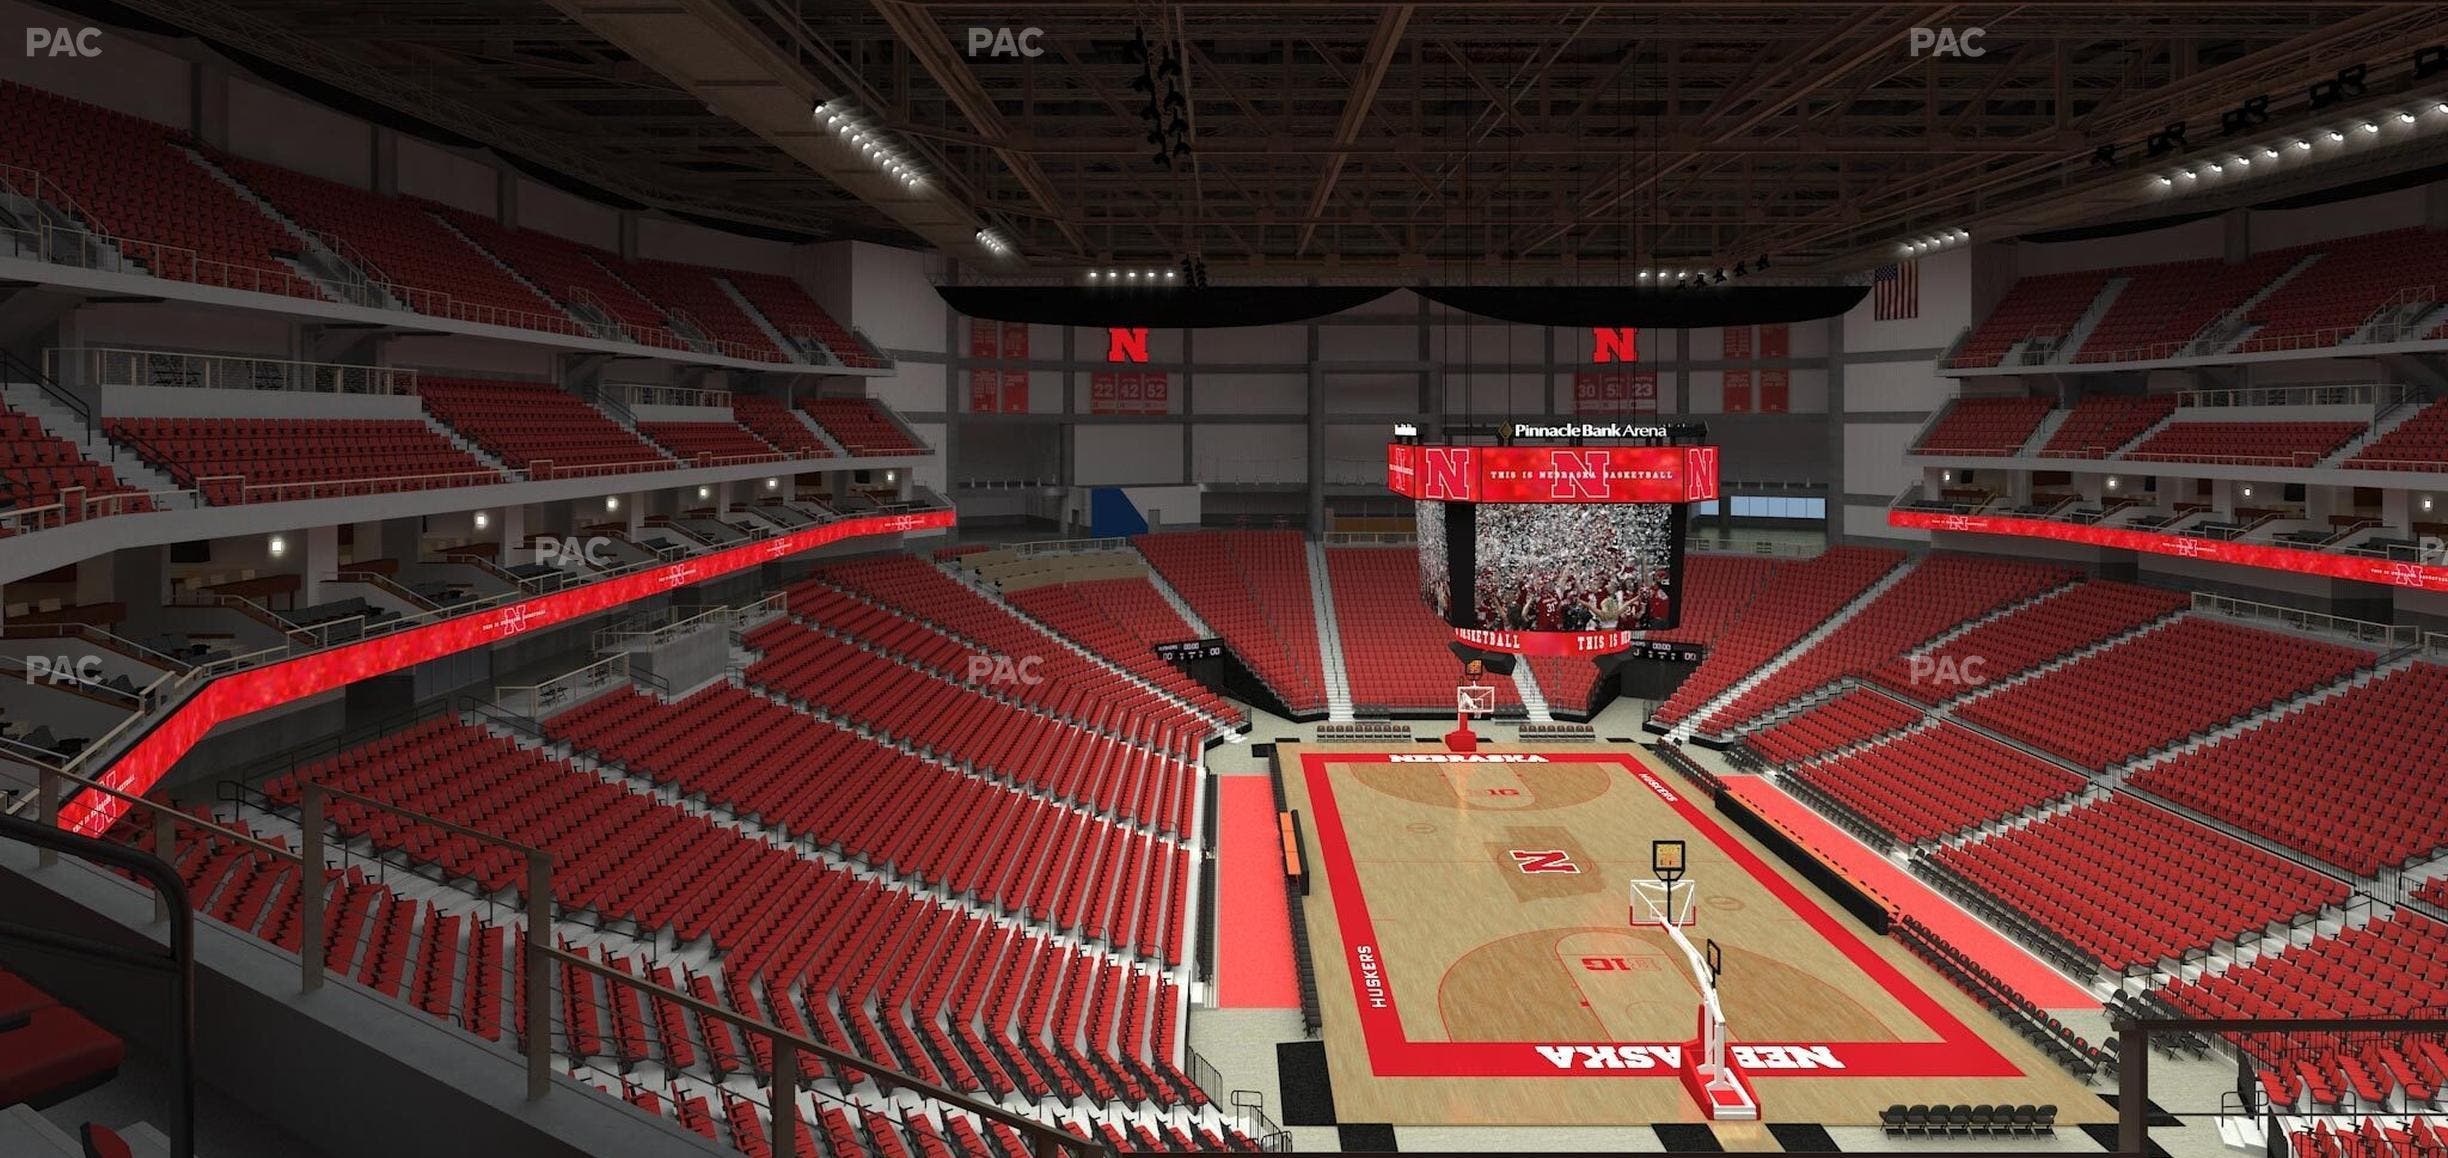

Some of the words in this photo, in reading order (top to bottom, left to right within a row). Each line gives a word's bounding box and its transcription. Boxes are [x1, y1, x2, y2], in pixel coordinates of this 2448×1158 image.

[1108, 328, 1149, 362] N
[1593, 328, 1639, 363] N
[1095, 383, 1114, 398] 22
[1120, 383, 1139, 398] 42
[1578, 386, 1596, 399] 30
[1632, 384, 1653, 398] 23
[1515, 423, 1581, 437] Pinnacle
[1582, 423, 1621, 437] Bank
[1622, 424, 1667, 437] Arena
[1426, 449, 1469, 499] N
[1490, 471, 1516, 479] THIS
[1522, 471, 1533, 479] IS
[1539, 471, 1596, 479] NEBRASKA
[1603, 471, 1673, 479] BASKETBALL
[1551, 451, 1609, 498] N
[1689, 449, 1712, 499] N
[1577, 635, 1605, 651] THIS
[1609, 633, 1618, 648] IS
[1389, 754, 1549, 763] NEBRASKA
[1357, 945, 1387, 1008] HUSKERS
[1534, 1045, 1847, 1069] NEBASKA
